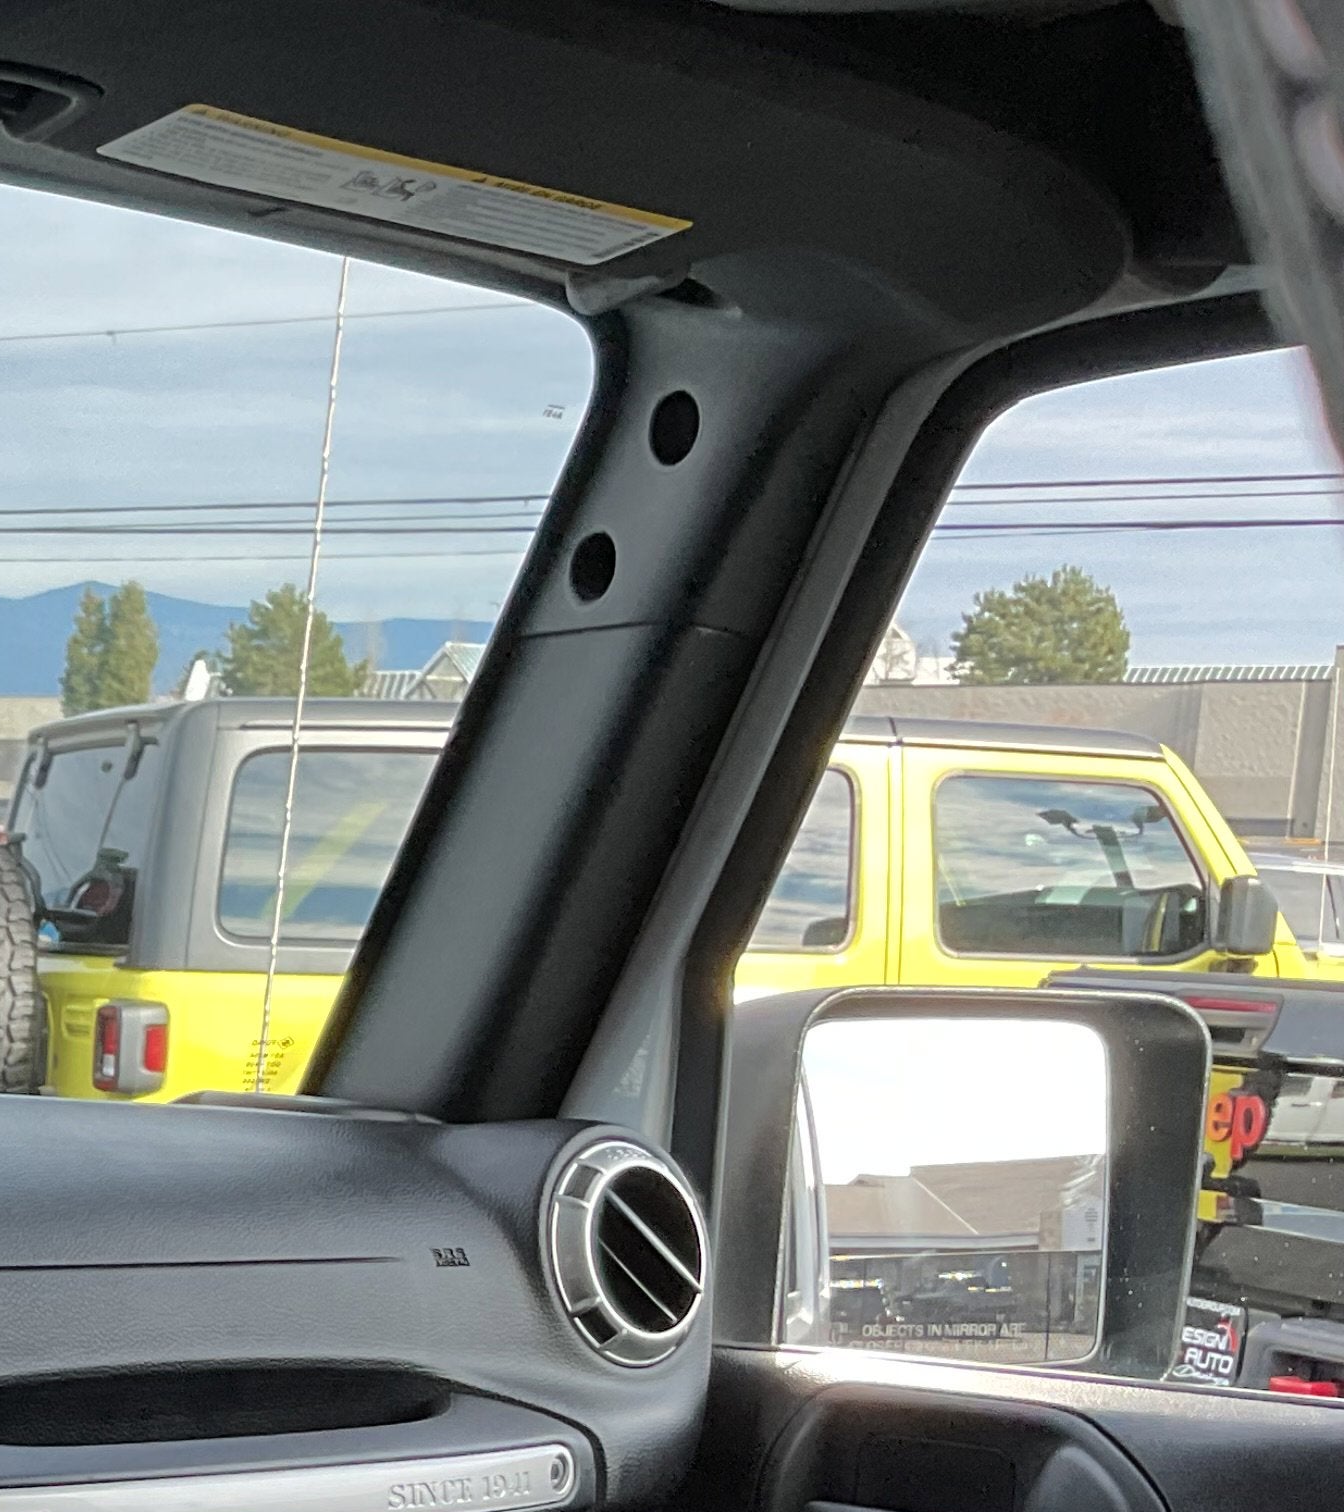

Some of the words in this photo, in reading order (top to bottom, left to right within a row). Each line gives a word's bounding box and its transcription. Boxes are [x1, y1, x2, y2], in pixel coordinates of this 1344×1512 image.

[1206, 1092, 1266, 1160] ep
[862, 1324, 923, 1338] OBJECTS
[928, 1324, 944, 1337] IN
[944, 1323, 996, 1337] MIRROR
[1181, 1325, 1228, 1351] ESIGN
[1184, 1346, 1234, 1374] AUTO
[387, 1477, 474, 1511] SINCE
